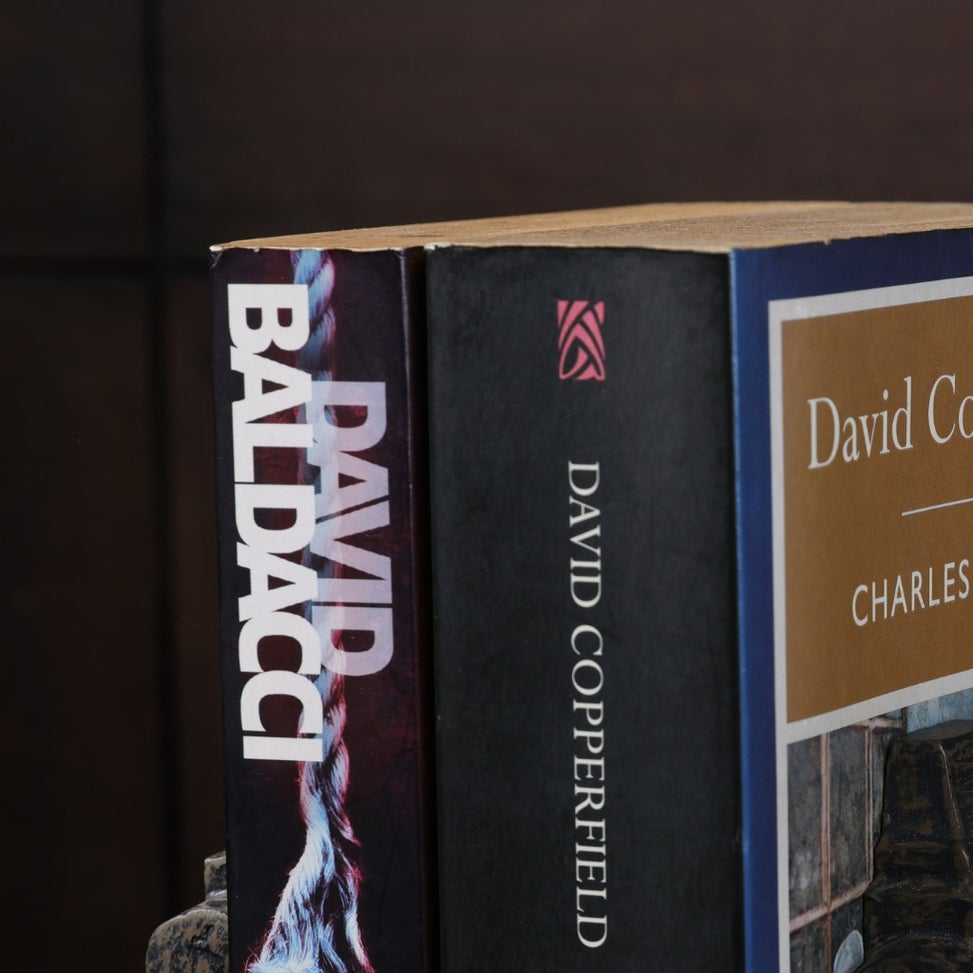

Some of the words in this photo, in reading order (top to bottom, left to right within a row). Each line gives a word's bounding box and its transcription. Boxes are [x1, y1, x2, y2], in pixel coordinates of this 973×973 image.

[227, 283, 323, 762] BALDACCI
[307, 381, 394, 677] DAVID
[807, 375, 914, 470] David
[567, 460, 602, 609] DAVID
[851, 558, 970, 627] CHARLES
[570, 624, 608, 949] COPPERFIELD
